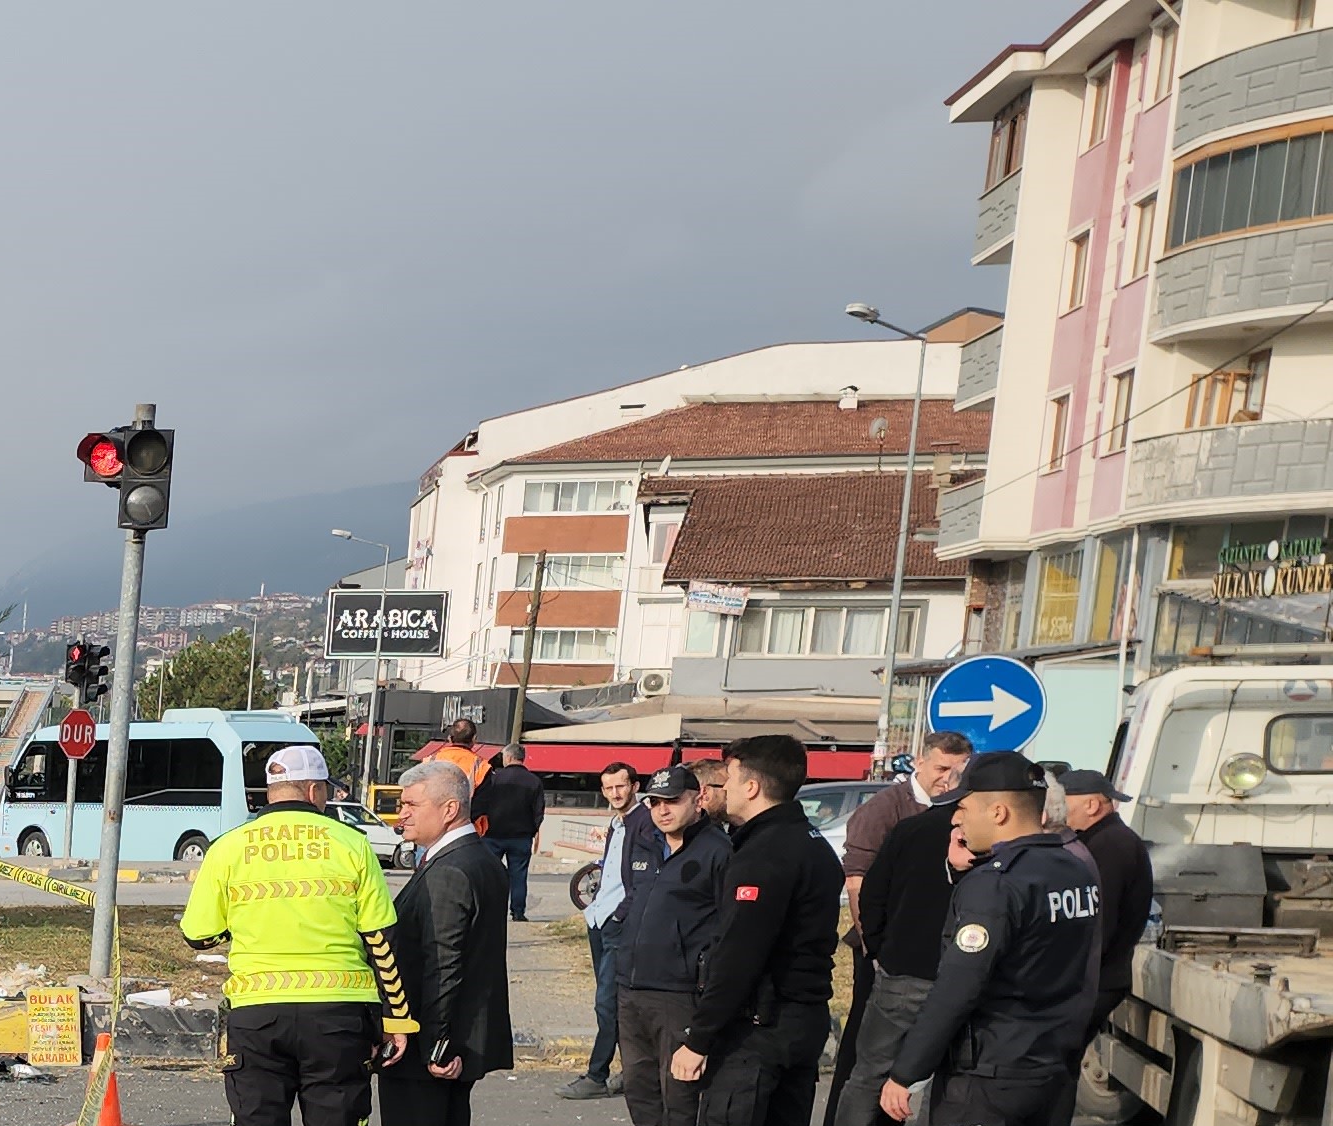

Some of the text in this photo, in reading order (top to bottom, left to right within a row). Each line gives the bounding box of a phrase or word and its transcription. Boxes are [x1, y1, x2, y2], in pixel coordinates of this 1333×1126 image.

[1281, 536, 1321, 559] KATMER
[335, 608, 439, 632] ARABICA
[391, 629, 430, 639] HOUSE
[62, 722, 93, 743] DUR
[244, 824, 331, 844] TRAFİK
[244, 842, 331, 865] POLİSİ
[1047, 885, 1101, 923] POLİS
[29, 994, 75, 1005] BULAK
